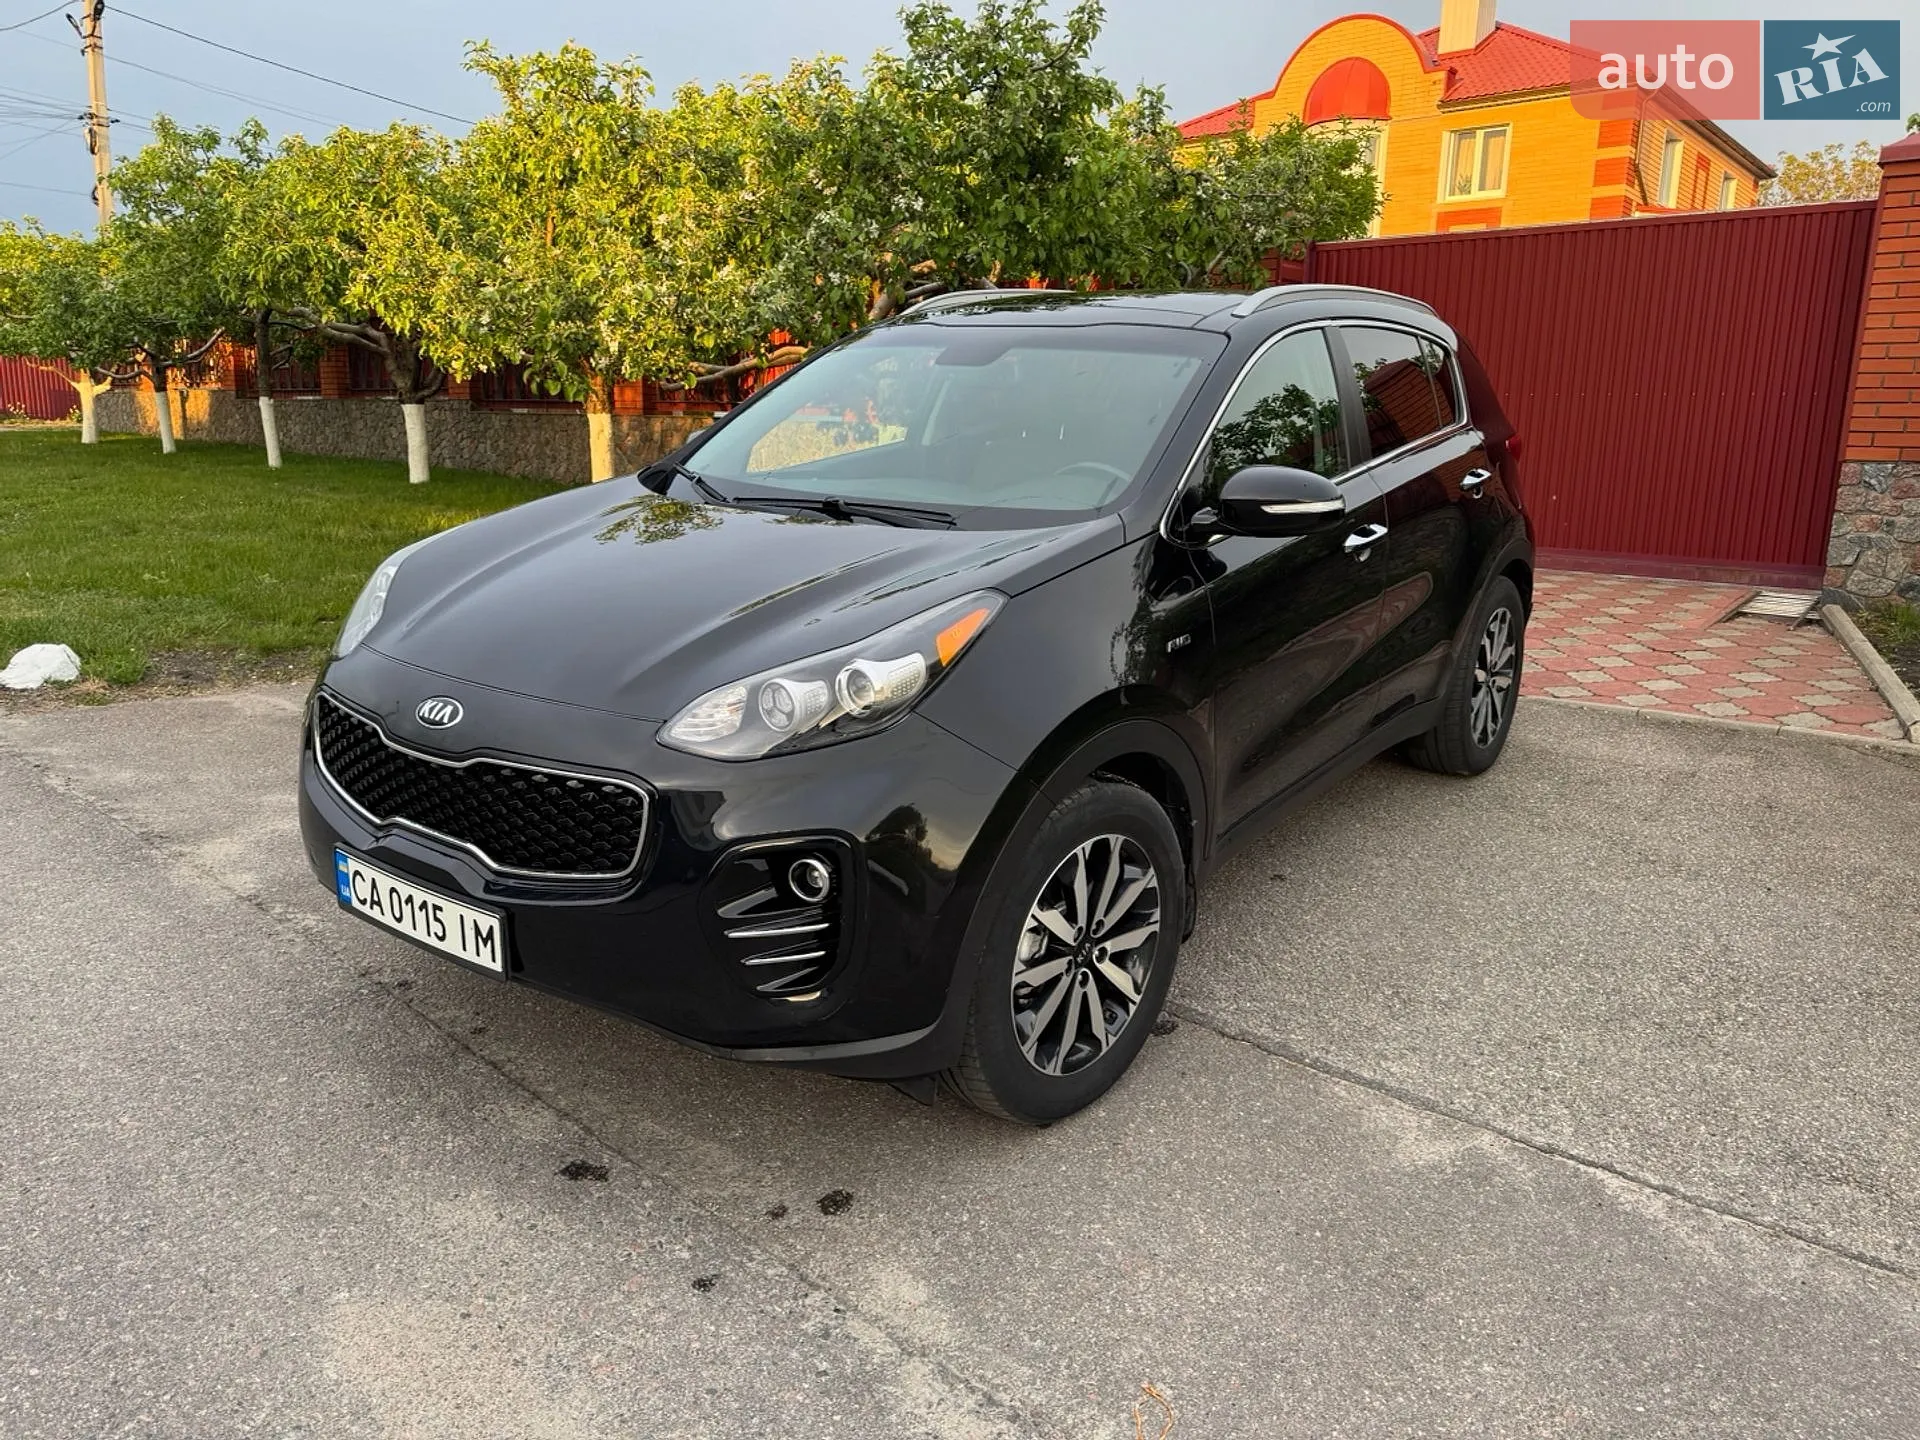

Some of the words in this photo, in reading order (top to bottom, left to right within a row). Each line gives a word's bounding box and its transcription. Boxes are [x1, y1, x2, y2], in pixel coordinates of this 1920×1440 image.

[418, 702, 453, 724] KIA
[352, 869, 384, 917] CA
[390, 887, 446, 943] 0115
[460, 913, 497, 964] IM
